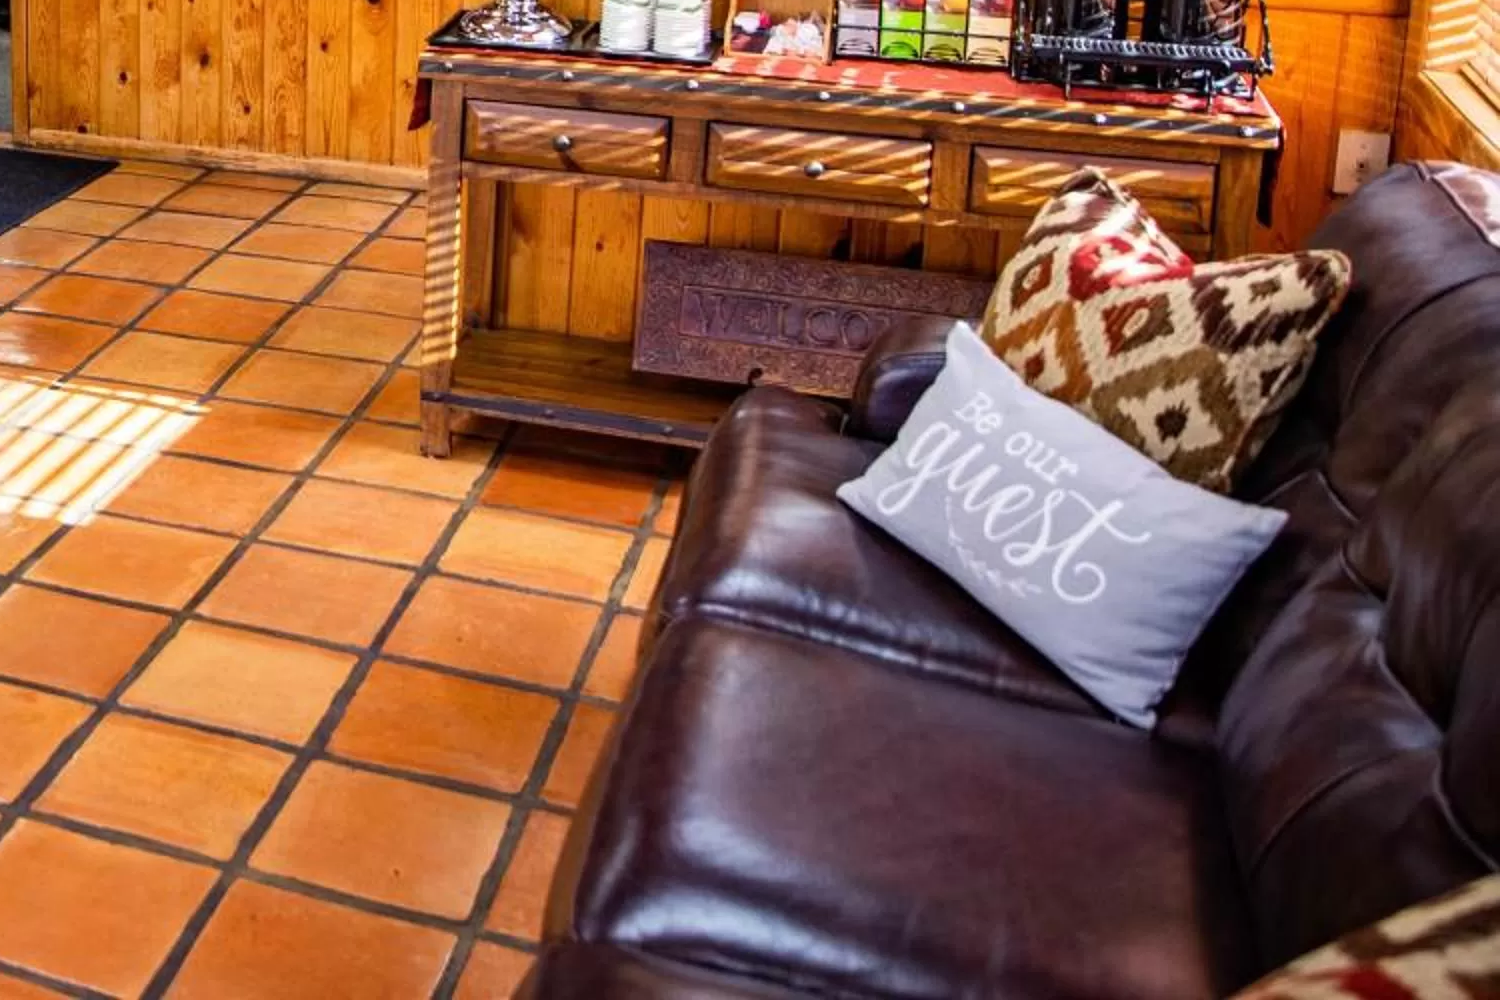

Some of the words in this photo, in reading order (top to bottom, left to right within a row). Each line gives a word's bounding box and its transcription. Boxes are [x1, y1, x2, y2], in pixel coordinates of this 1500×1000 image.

[690, 293, 892, 351] WELCO
[954, 391, 1003, 434] Be
[1004, 431, 1079, 485] our
[876, 421, 1152, 604] guest
